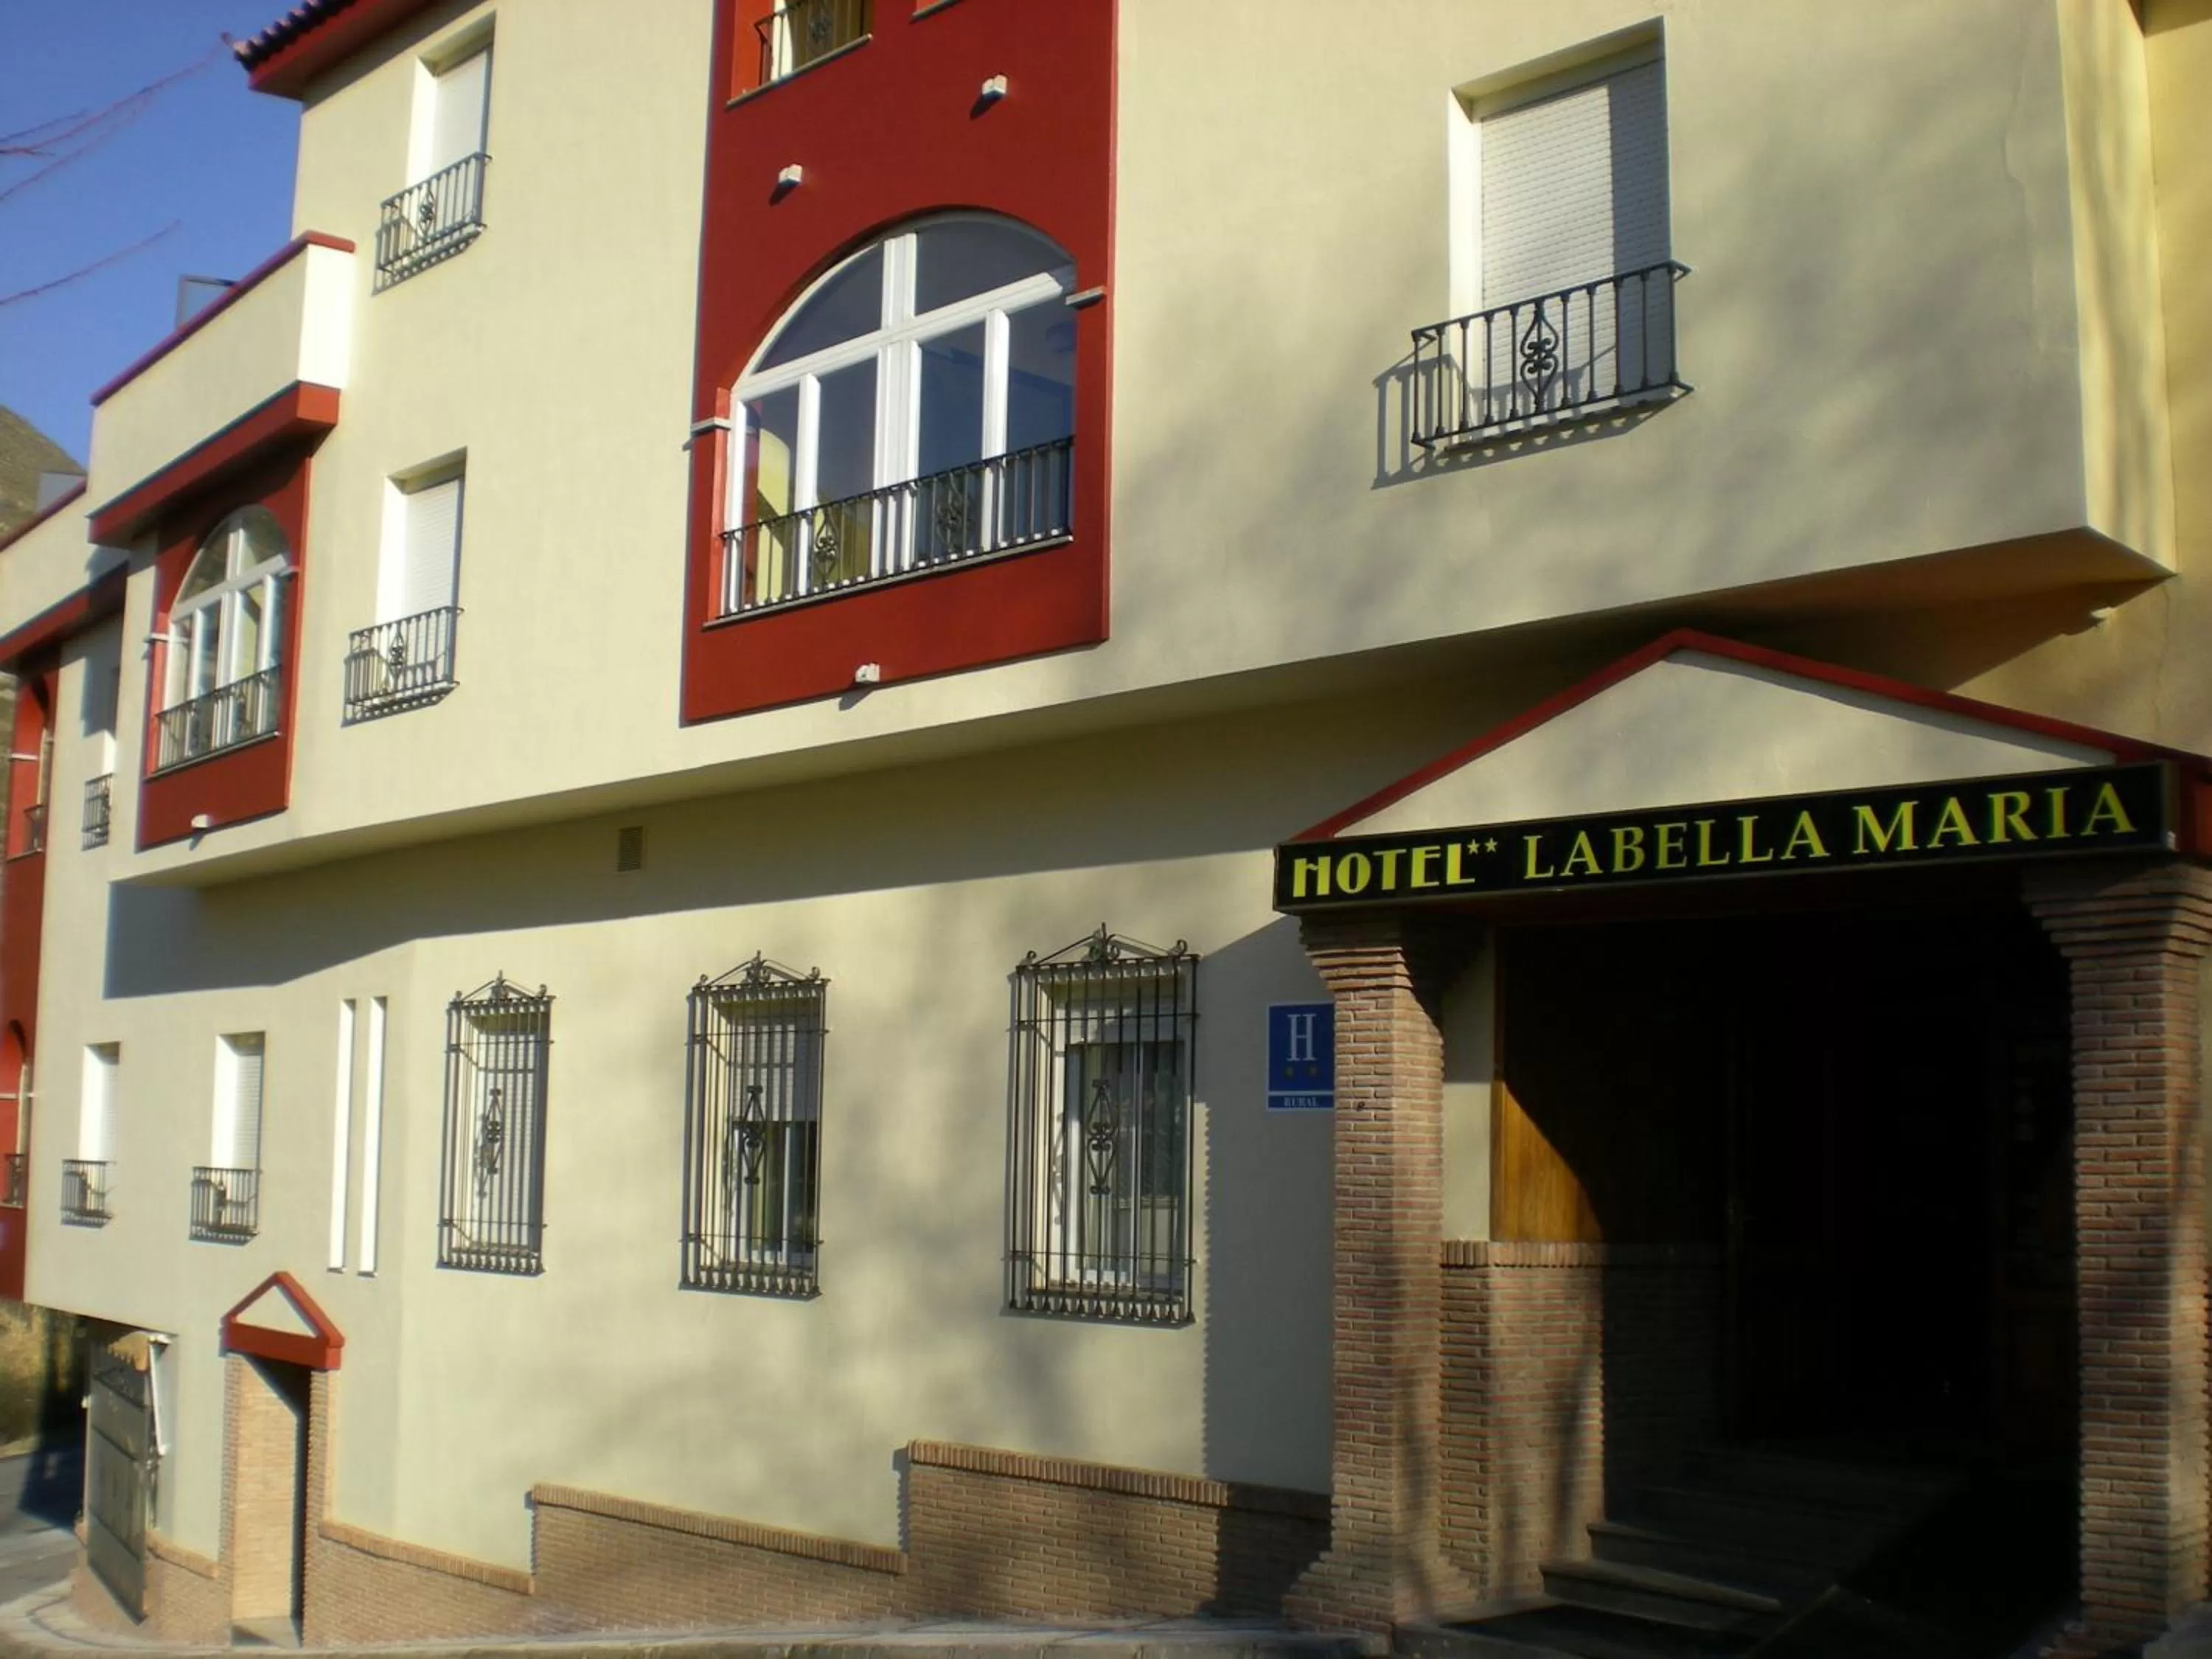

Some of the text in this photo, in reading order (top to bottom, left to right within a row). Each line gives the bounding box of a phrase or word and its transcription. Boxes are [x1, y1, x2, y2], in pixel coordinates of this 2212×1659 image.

[1293, 843, 1475, 897] HOTEL
[1852, 782, 2136, 854] MARIA
[1287, 1013, 1317, 1061] H
